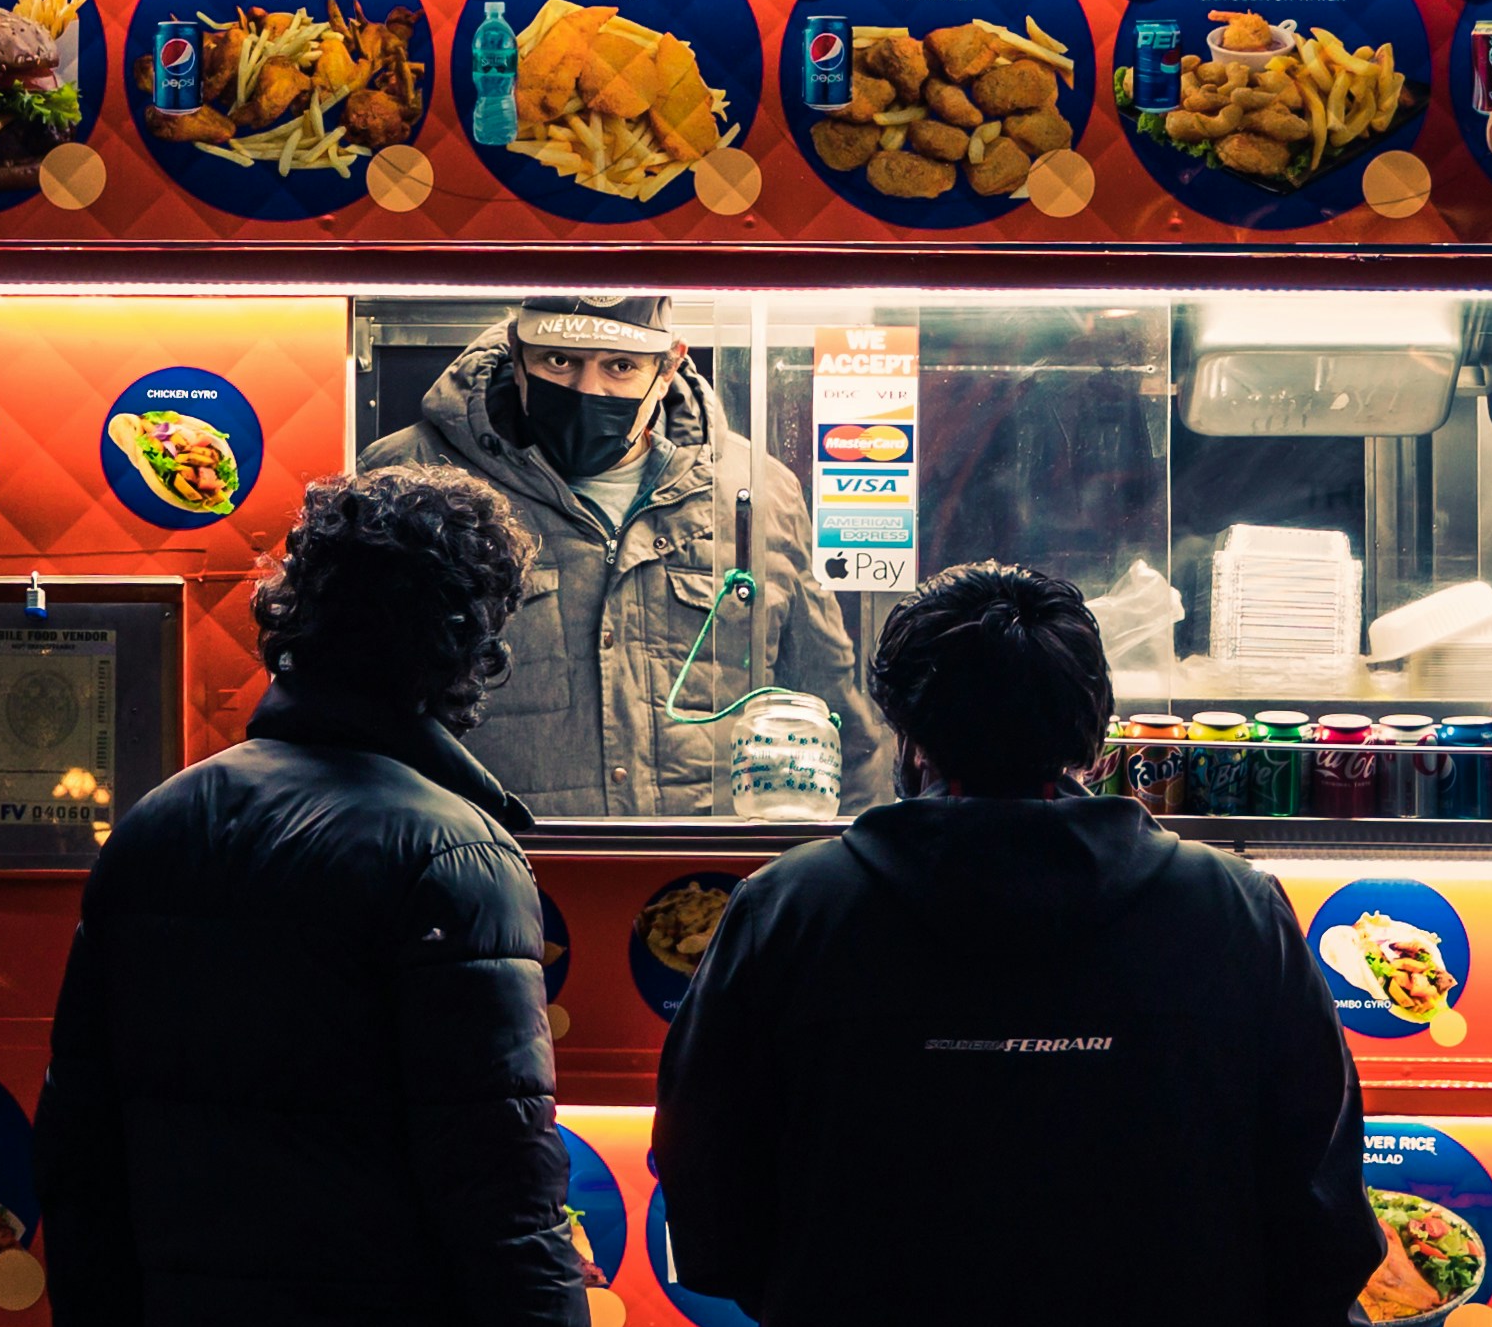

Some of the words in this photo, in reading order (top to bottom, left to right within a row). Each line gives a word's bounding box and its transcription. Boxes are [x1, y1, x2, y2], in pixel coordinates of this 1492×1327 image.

[536, 317, 589, 335] NEW
[591, 319, 648, 343] YORK
[846, 330, 886, 350] WE
[817, 354, 915, 375] ACCEPT
[146, 388, 189, 399] CHICKEN
[190, 389, 218, 400] GYRO
[823, 389, 909, 400] DISCVER
[826, 437, 905, 450] MasterCard
[836, 478, 898, 493] VISA
[822, 516, 902, 529] AMERICAN
[842, 529, 907, 542] EXPRESS
[855, 552, 906, 588] Pay
[27, 631, 58, 642] FOOD
[62, 631, 109, 642] VENDOR
[0, 804, 28, 821] FV
[32, 806, 91, 820] 04060
[1334, 999, 1362, 1009] OMBO
[1364, 999, 1392, 1009] GYRO
[1004, 1036, 1113, 1053] FERRARI
[1363, 1135, 1396, 1150] VER
[1399, 1136, 1436, 1151] RICE
